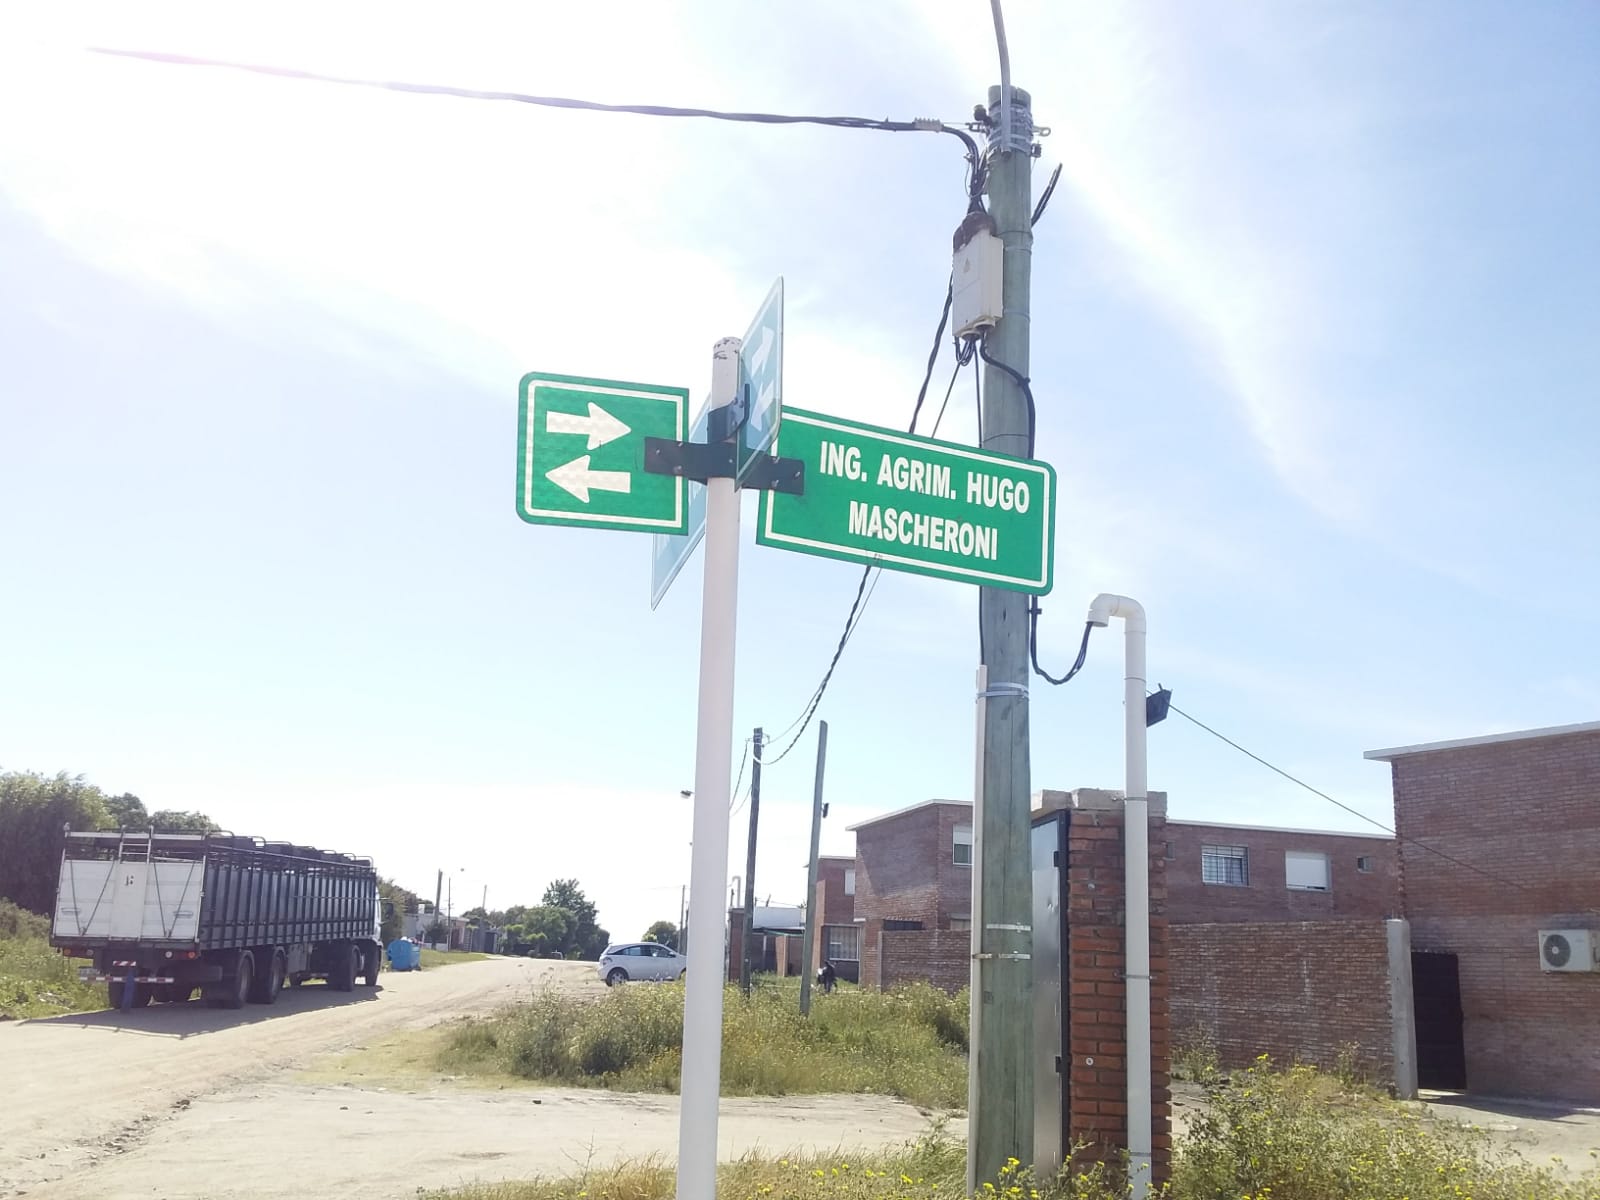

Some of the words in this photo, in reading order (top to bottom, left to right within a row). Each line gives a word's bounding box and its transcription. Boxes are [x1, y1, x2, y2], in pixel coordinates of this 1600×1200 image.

[819, 441, 867, 482] ING.
[877, 454, 956, 499] AGRIM.
[966, 471, 1029, 513] HUGO
[848, 501, 997, 560] MASCHERONI
